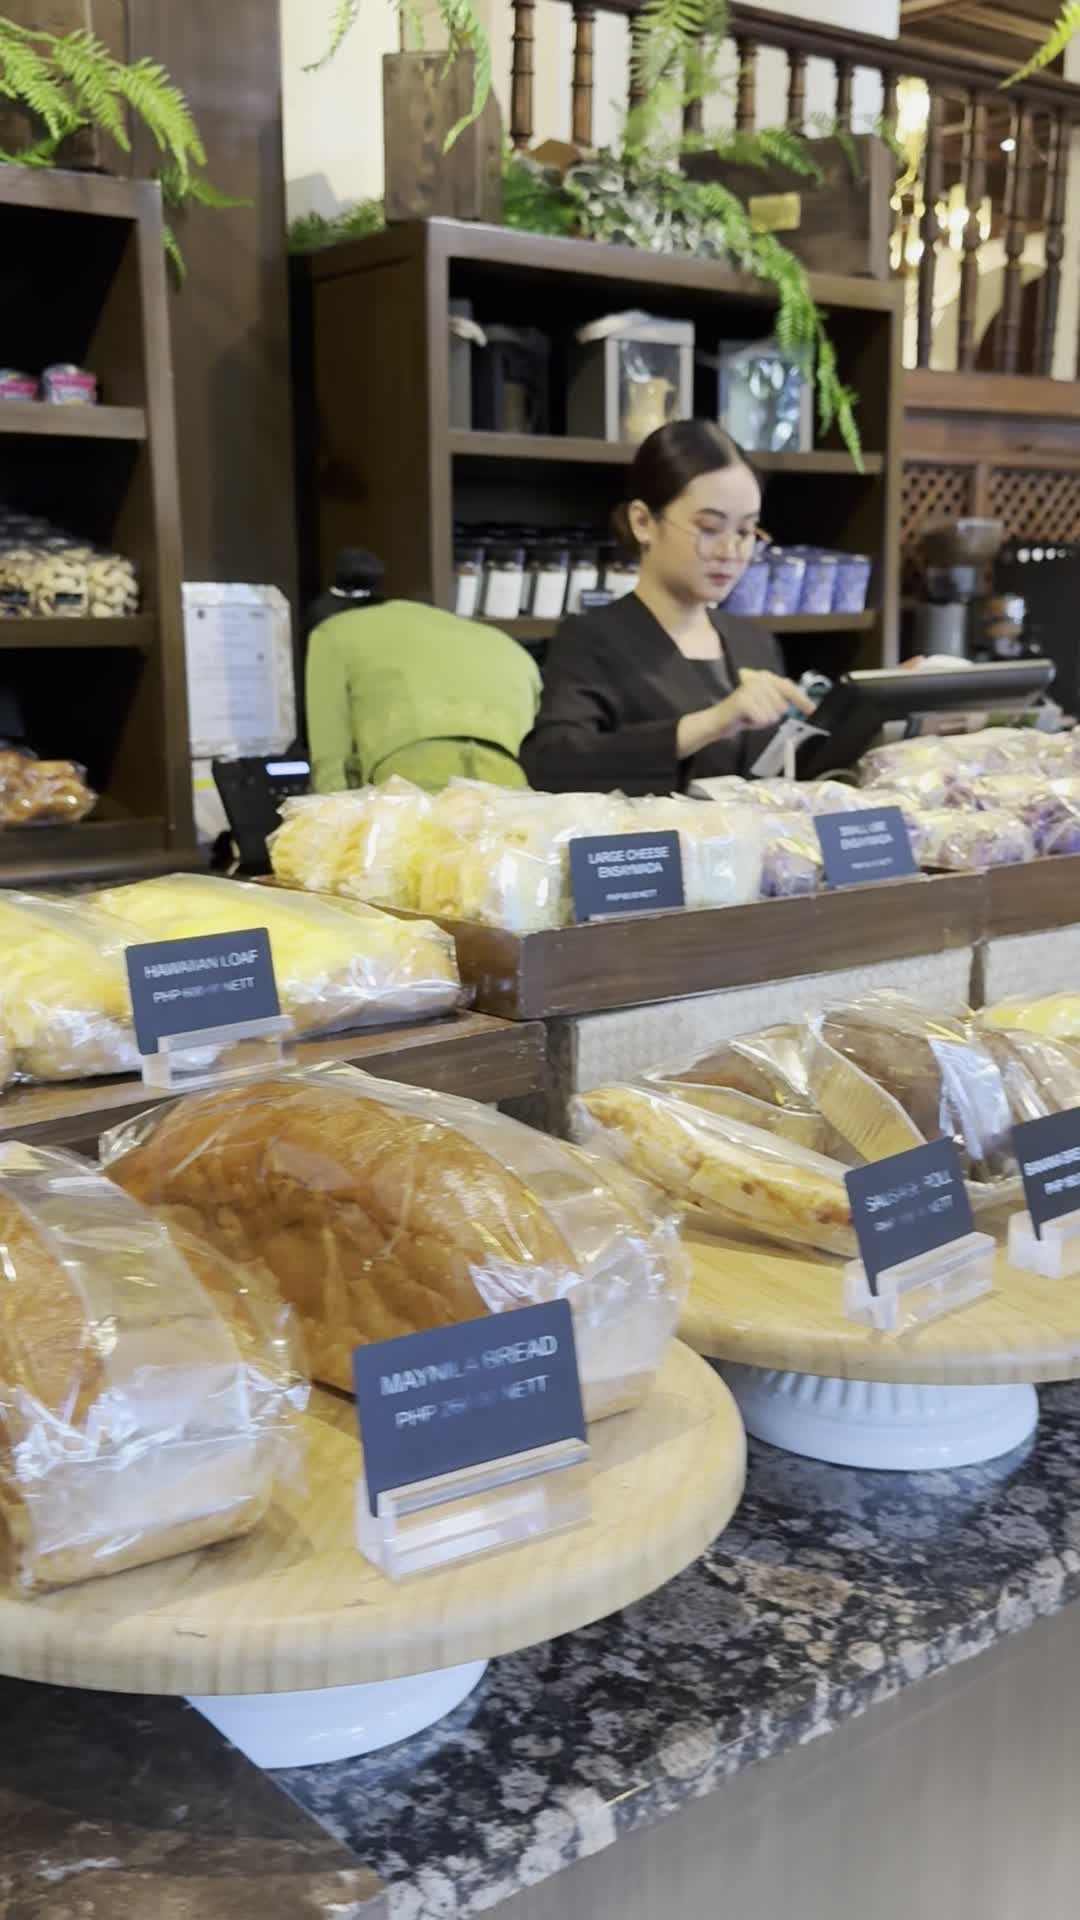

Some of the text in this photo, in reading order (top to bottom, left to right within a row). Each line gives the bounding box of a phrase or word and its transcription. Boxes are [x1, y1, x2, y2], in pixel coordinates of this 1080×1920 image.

[219, 948, 258, 968] LOAF
[482, 1335, 558, 1369] BREAD
[394, 1404, 437, 1431] PHP
